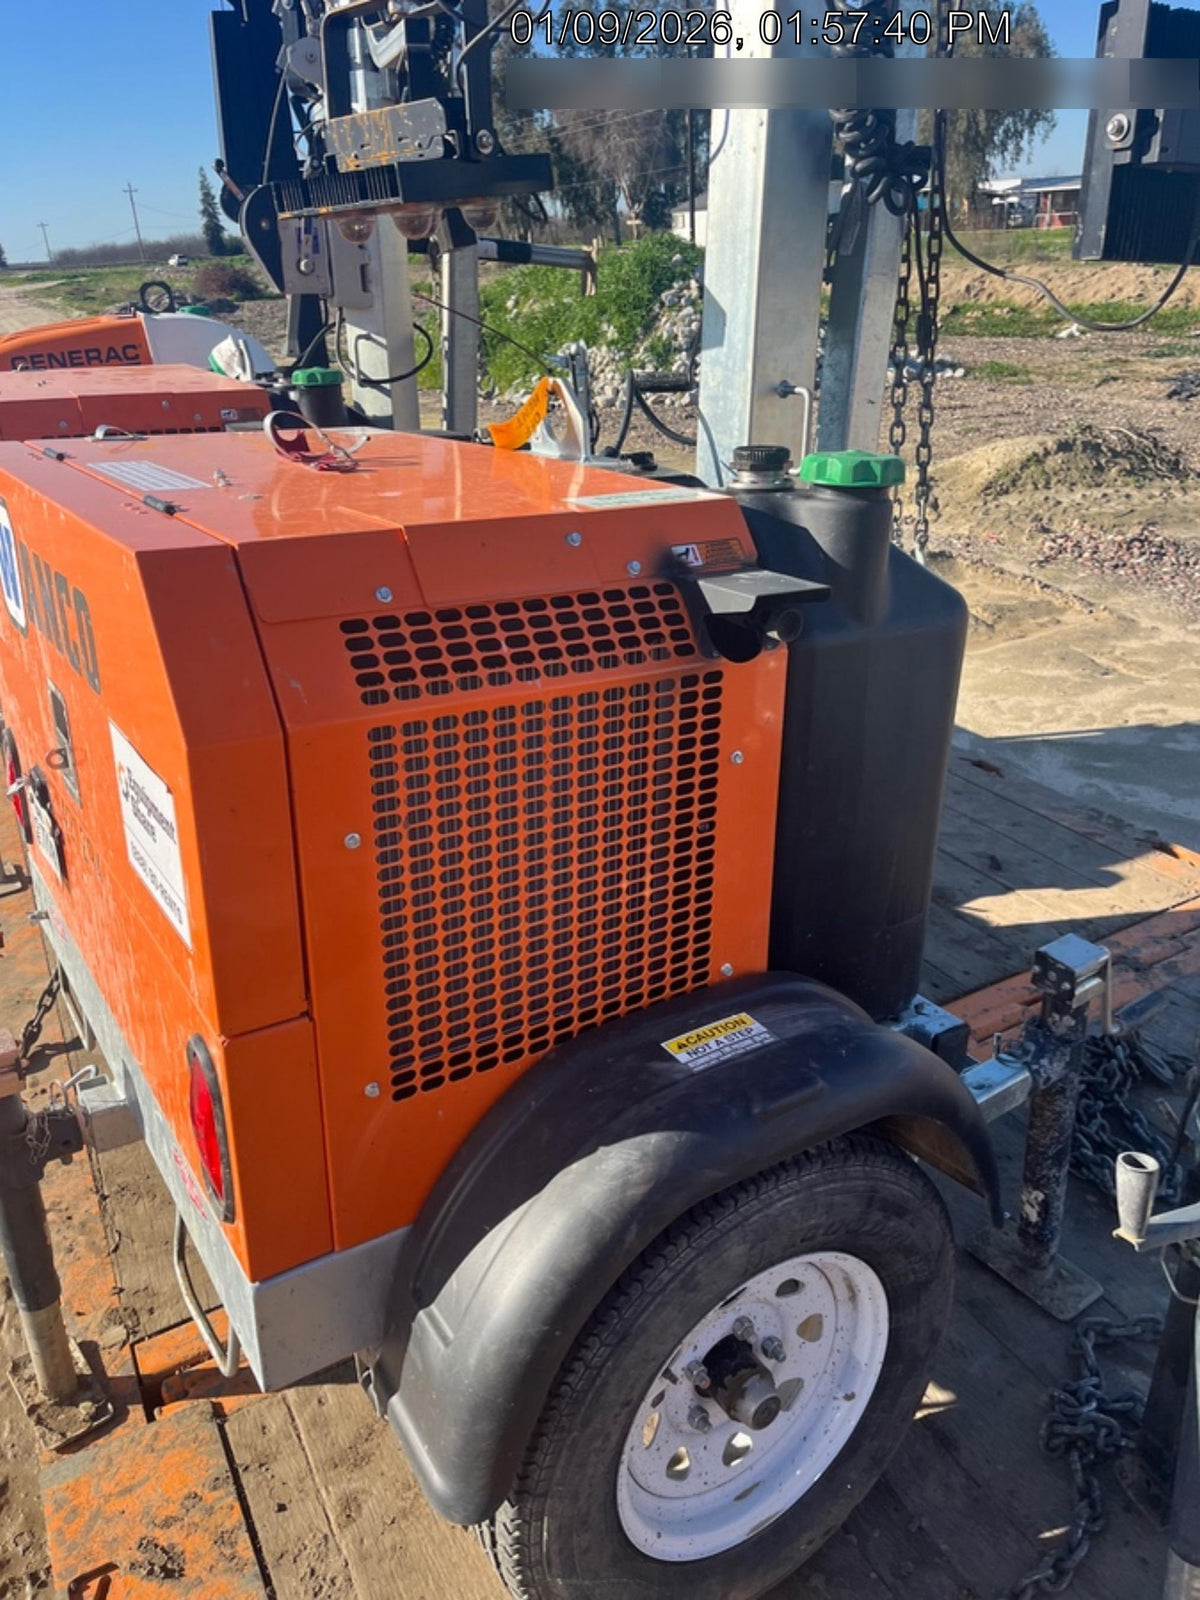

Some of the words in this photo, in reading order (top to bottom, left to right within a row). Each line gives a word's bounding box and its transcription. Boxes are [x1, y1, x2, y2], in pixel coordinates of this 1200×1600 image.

[10, 344, 140, 371] GENERAC
[685, 1018, 748, 1045] CAUTION
[686, 1042, 713, 1058] NOT
[724, 1027, 754, 1042] STEP
